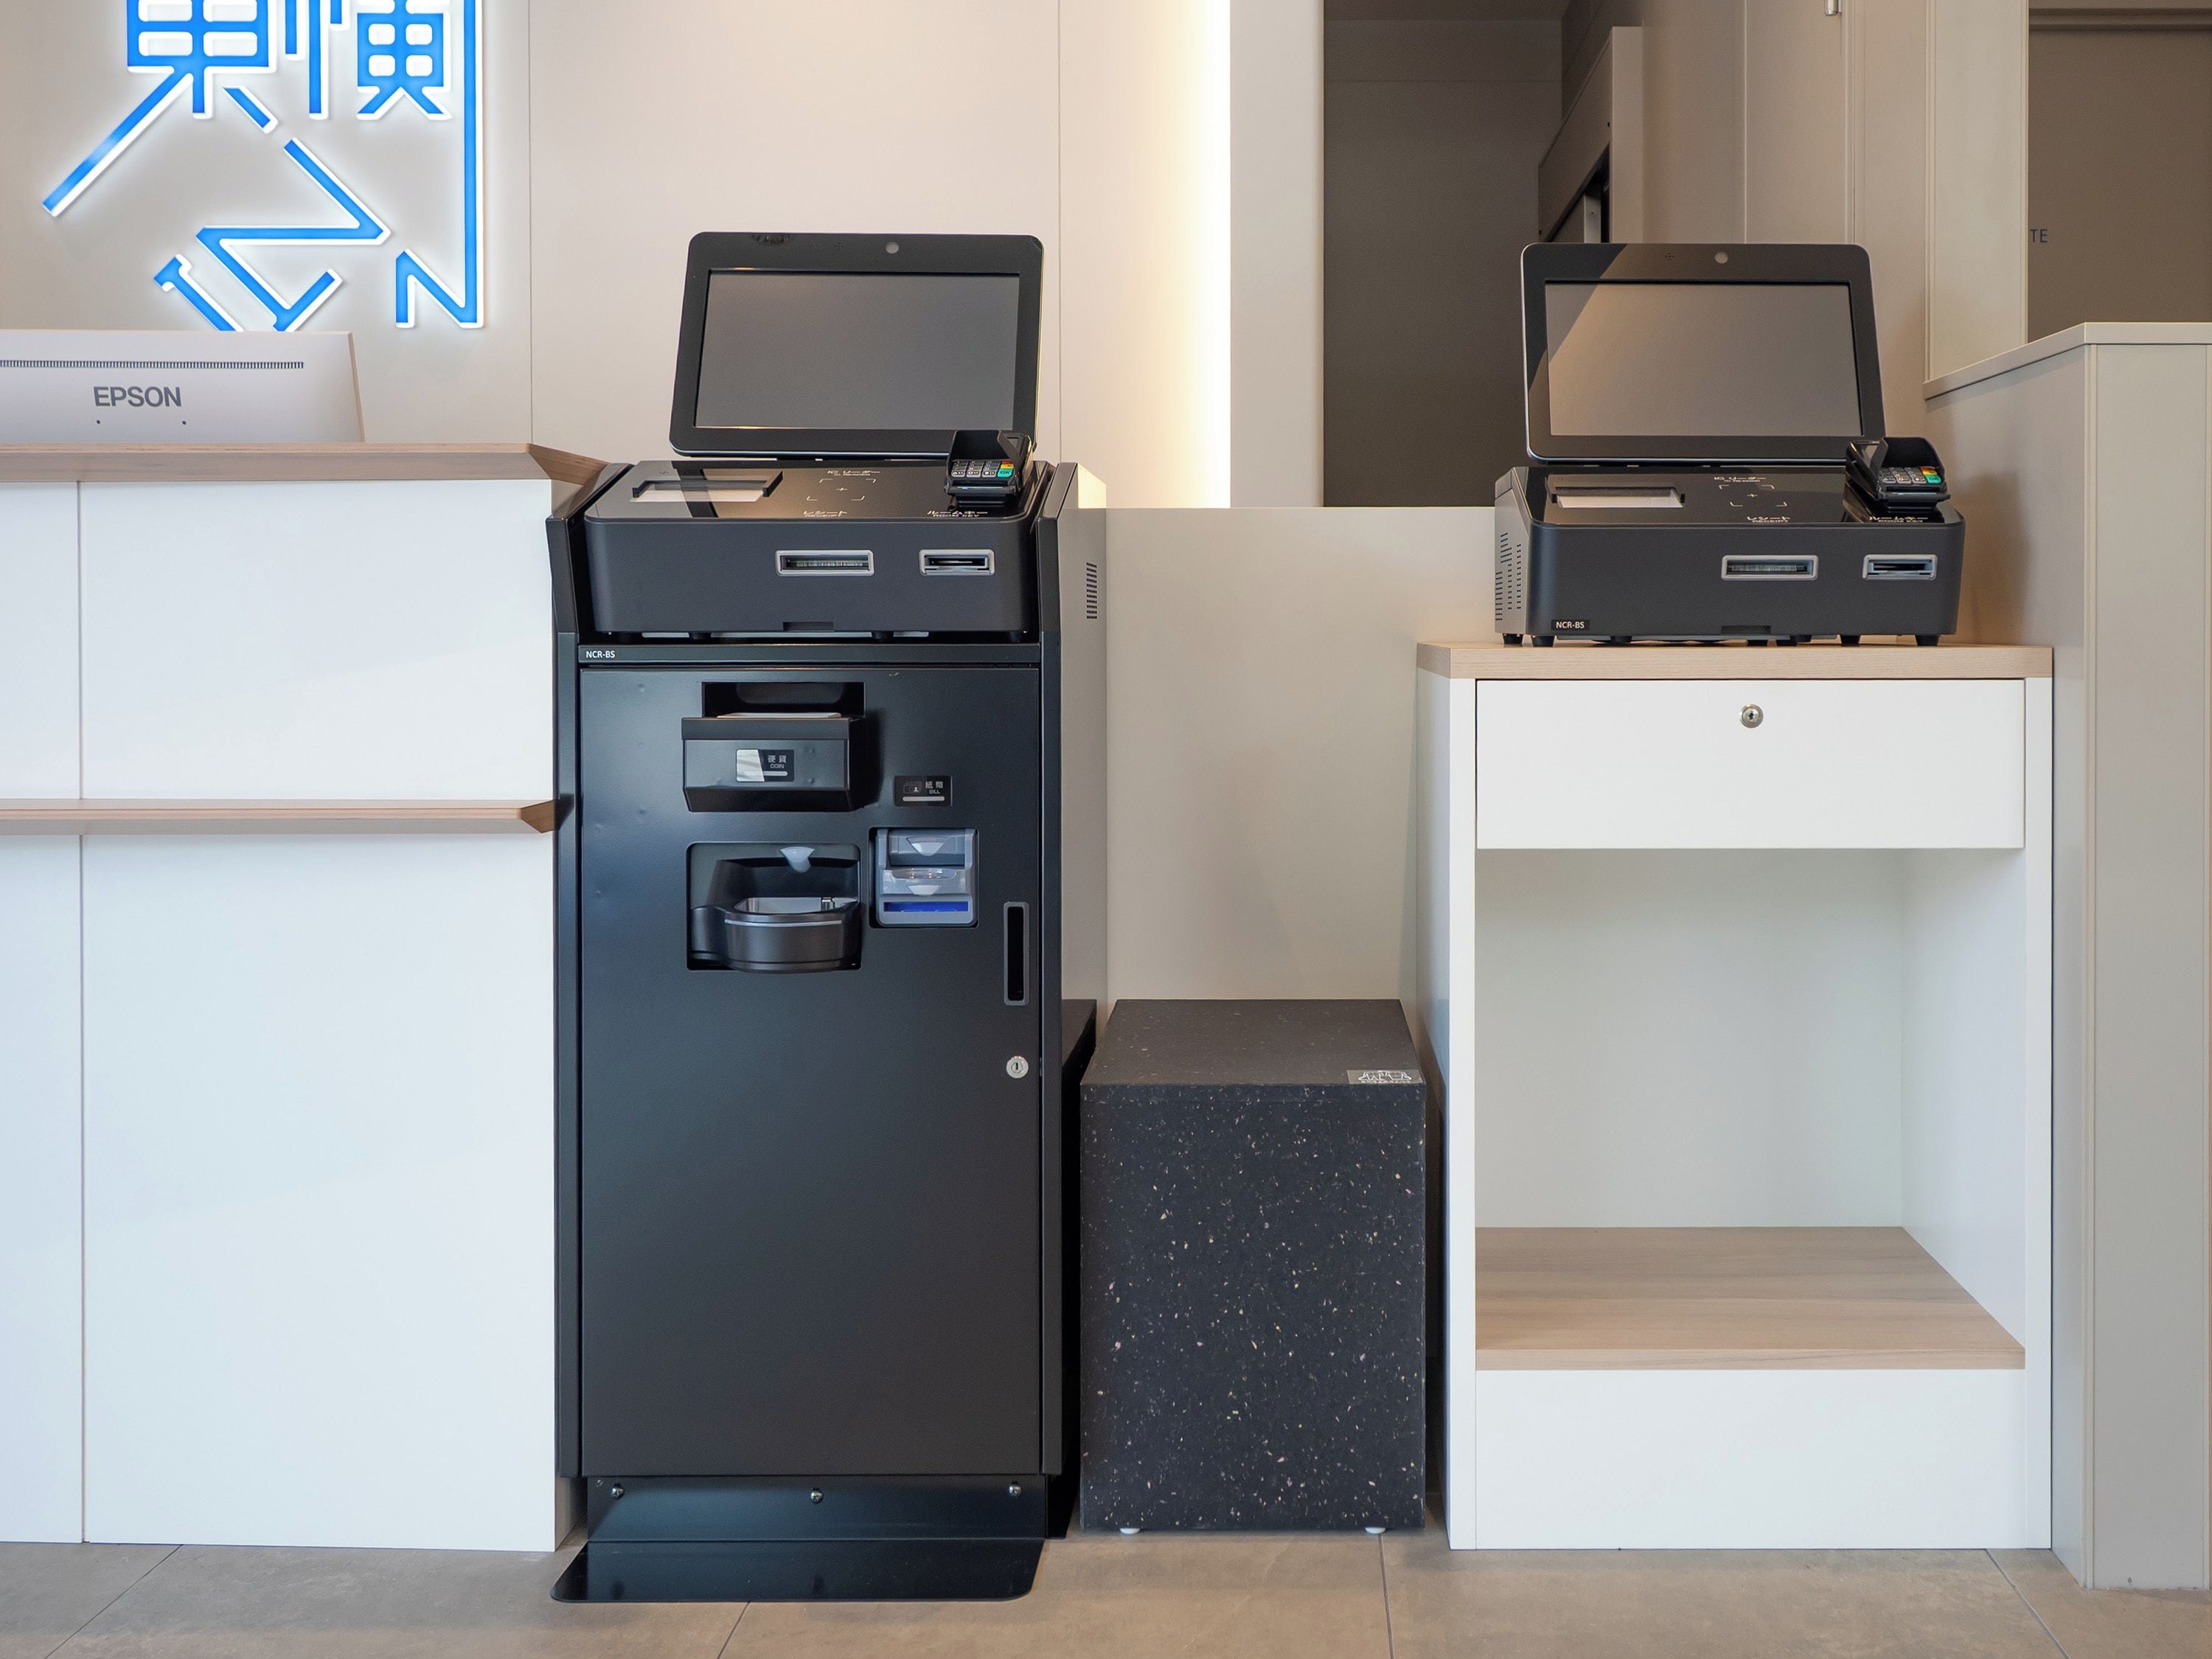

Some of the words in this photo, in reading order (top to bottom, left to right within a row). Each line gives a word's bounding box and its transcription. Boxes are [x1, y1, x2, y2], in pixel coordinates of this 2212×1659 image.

[93, 386, 182, 407] EPSON
[1556, 621, 1585, 629] NCR-BS
[585, 650, 616, 658] NCR-BS
